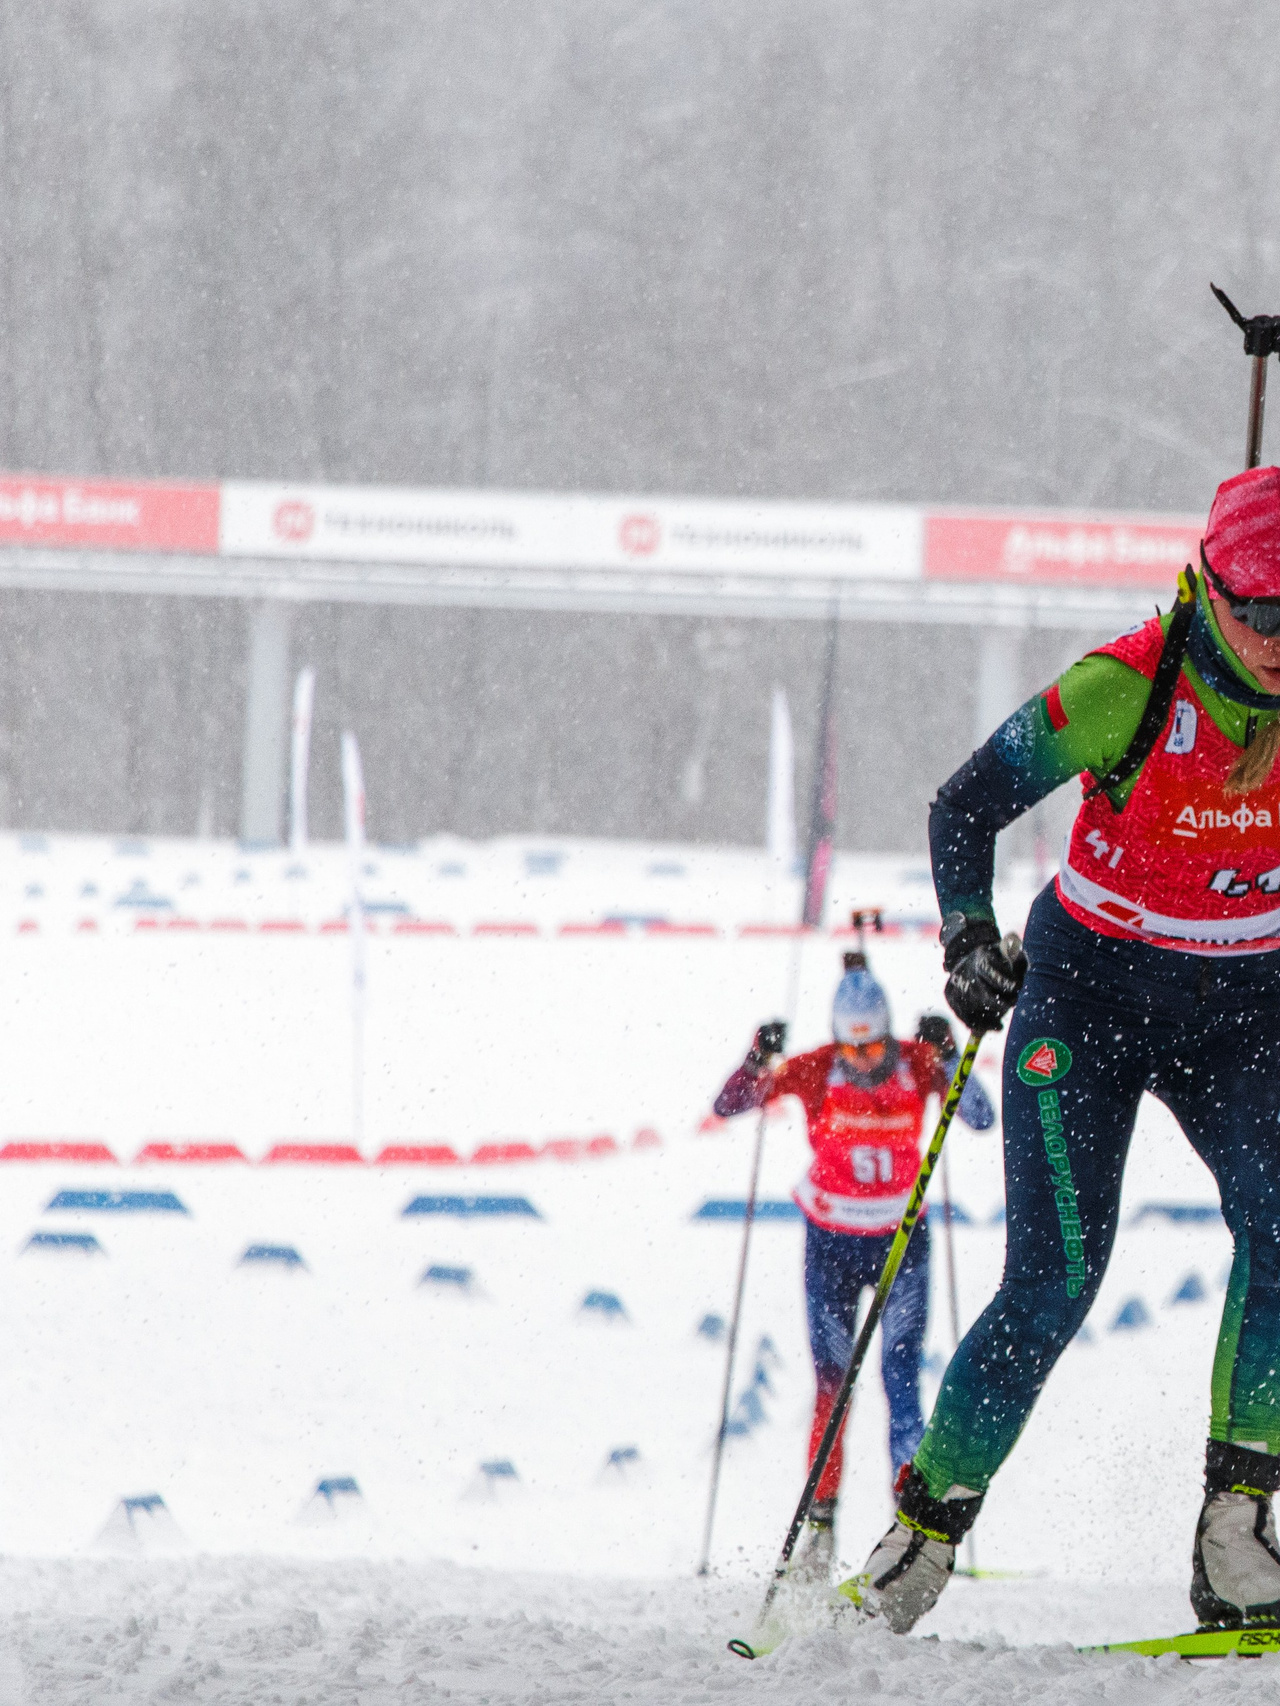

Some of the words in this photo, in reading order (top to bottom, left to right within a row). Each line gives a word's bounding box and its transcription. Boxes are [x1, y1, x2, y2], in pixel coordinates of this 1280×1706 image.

[1176, 802, 1272, 834] Альфа
[1085, 829, 1124, 869] 41
[851, 1145, 894, 1184] 51
[1038, 1089, 1086, 1300] БЕЛОРУСНЕФТЬ
